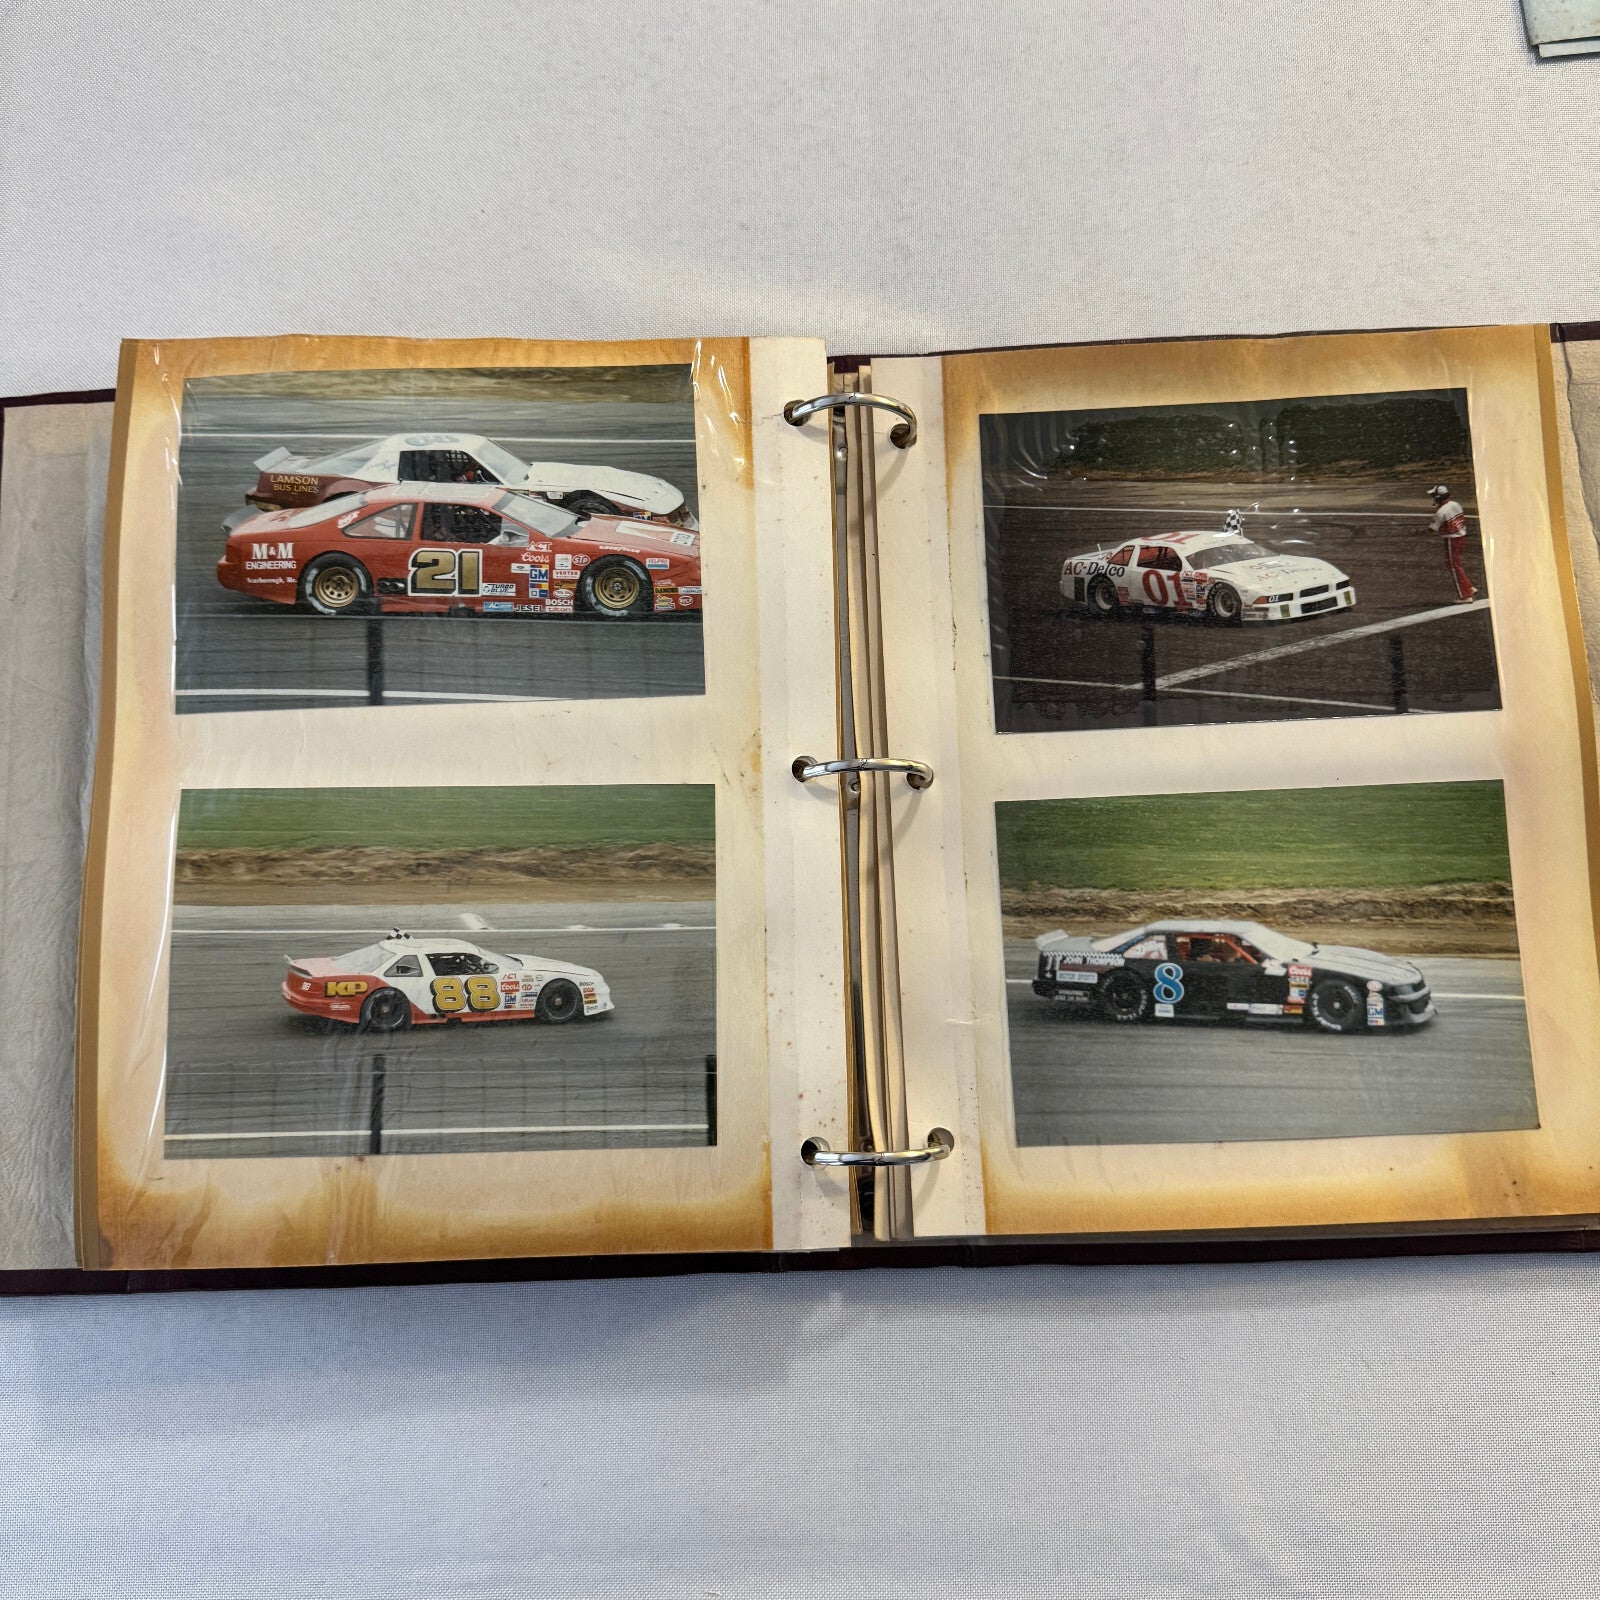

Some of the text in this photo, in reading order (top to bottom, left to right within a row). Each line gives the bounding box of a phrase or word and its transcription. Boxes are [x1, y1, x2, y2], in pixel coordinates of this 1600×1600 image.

[270, 475, 319, 485] LAMSON
[294, 485, 319, 493] LINES
[252, 543, 294, 559] M&M
[521, 552, 549, 562] Coors
[246, 561, 297, 570] ENGINEERING
[408, 548, 483, 597] 21
[530, 569, 548, 579] GM
[1142, 569, 1194, 608] 01
[1268, 595, 1280, 603] 01
[515, 604, 543, 612] JESEL
[1153, 962, 1185, 1004] 8
[325, 981, 368, 998] KP
[431, 976, 500, 1013] 88
[505, 995, 516, 1003] GM
[1367, 1008, 1384, 1017] GM
